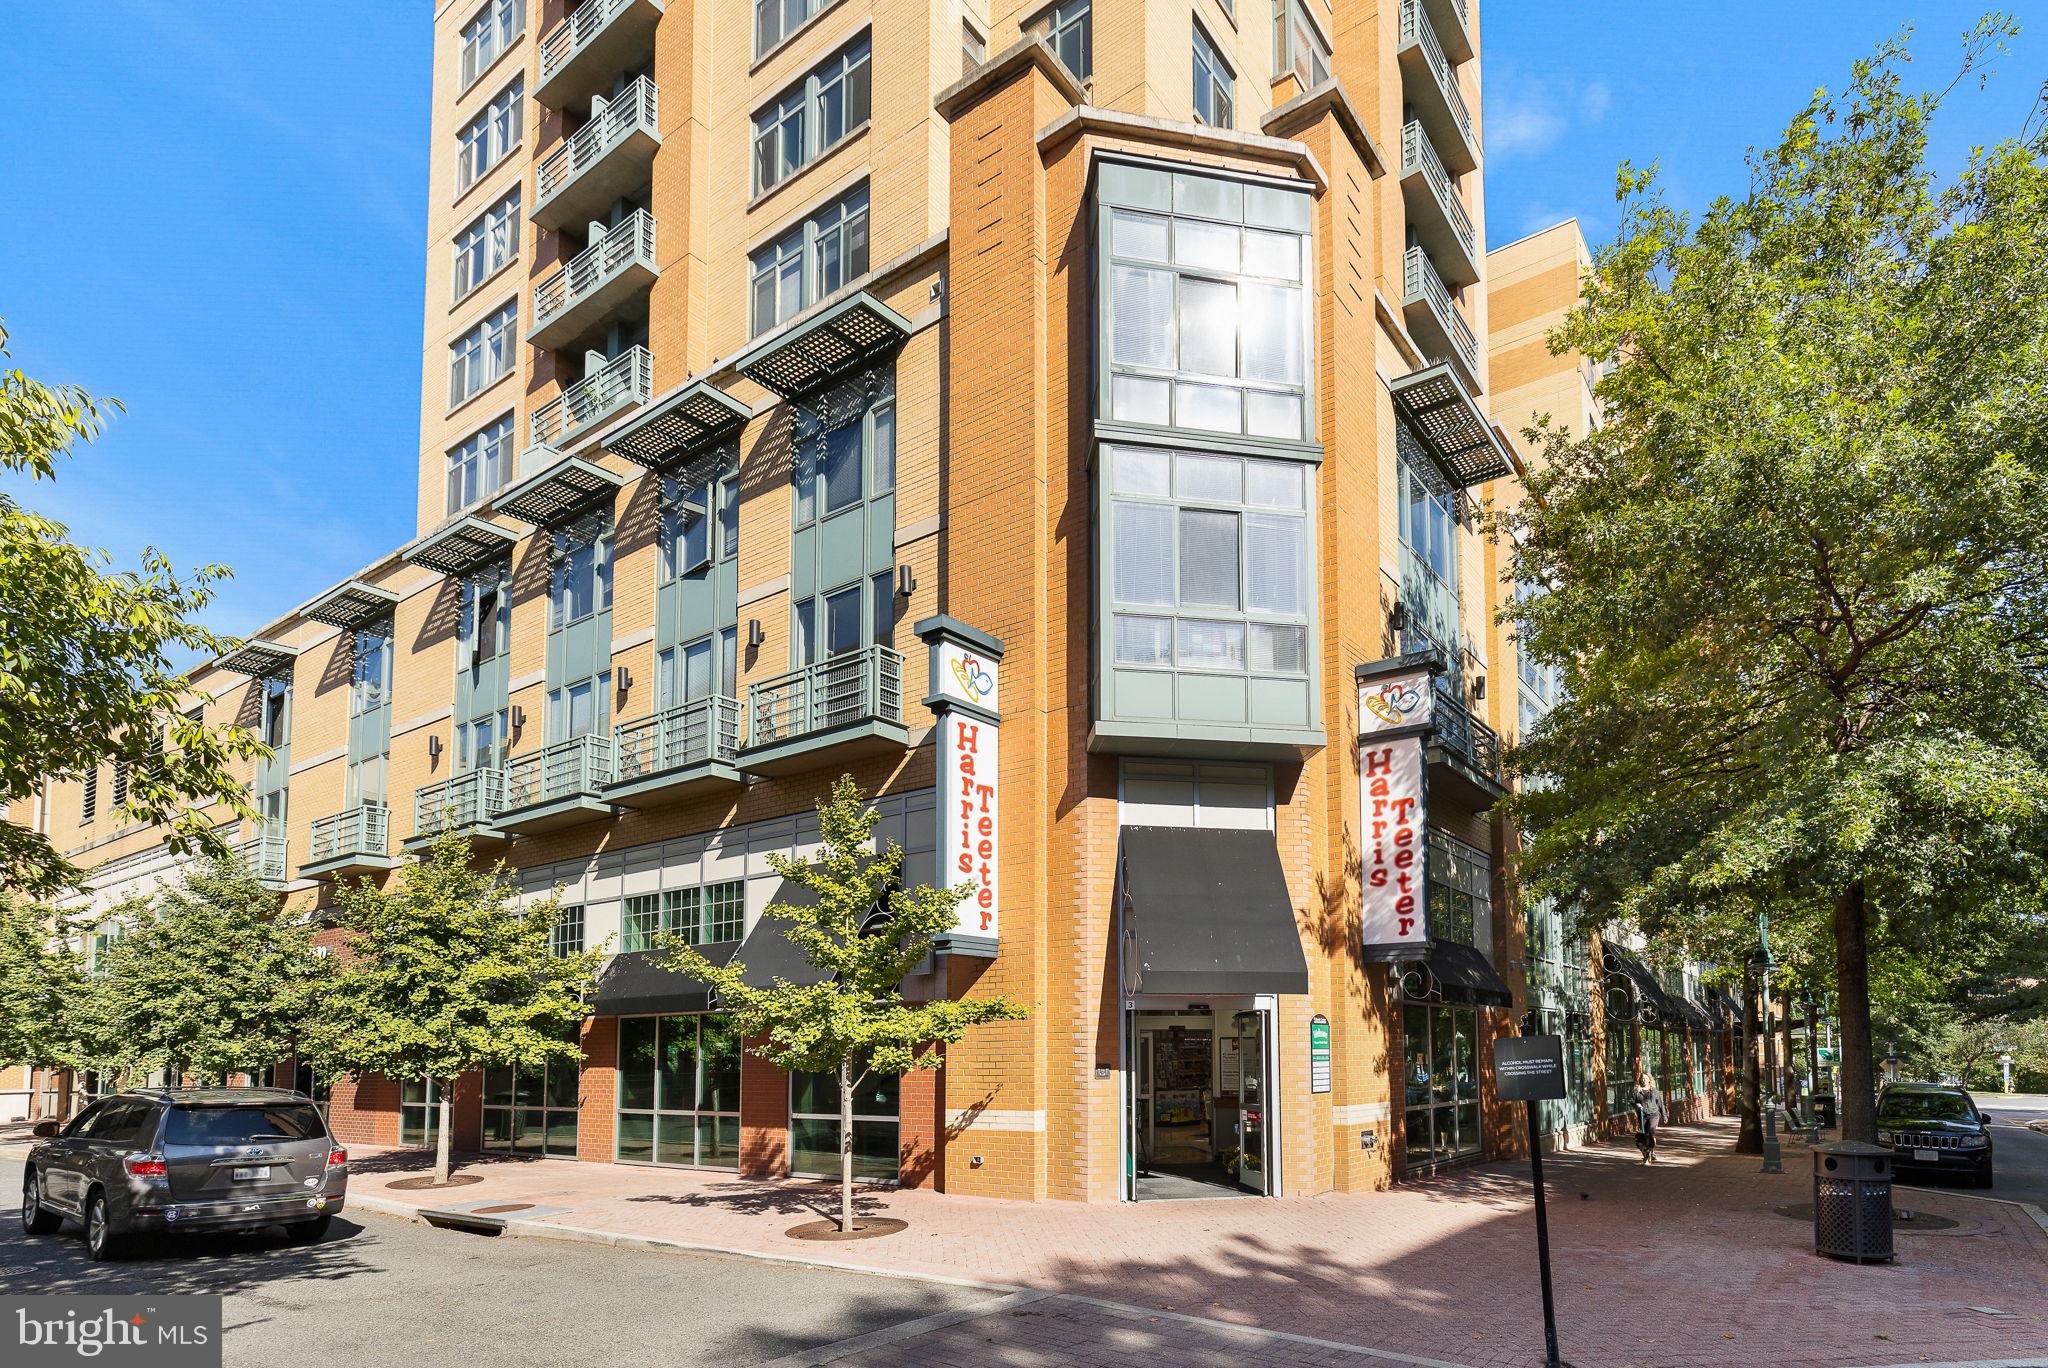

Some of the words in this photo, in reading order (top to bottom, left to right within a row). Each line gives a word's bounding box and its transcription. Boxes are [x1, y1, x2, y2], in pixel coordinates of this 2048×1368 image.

[956, 721, 979, 874] Harris
[975, 783, 994, 932] Teeter
[1365, 747, 1394, 888] Harris
[1390, 797, 1415, 937] Teeter
